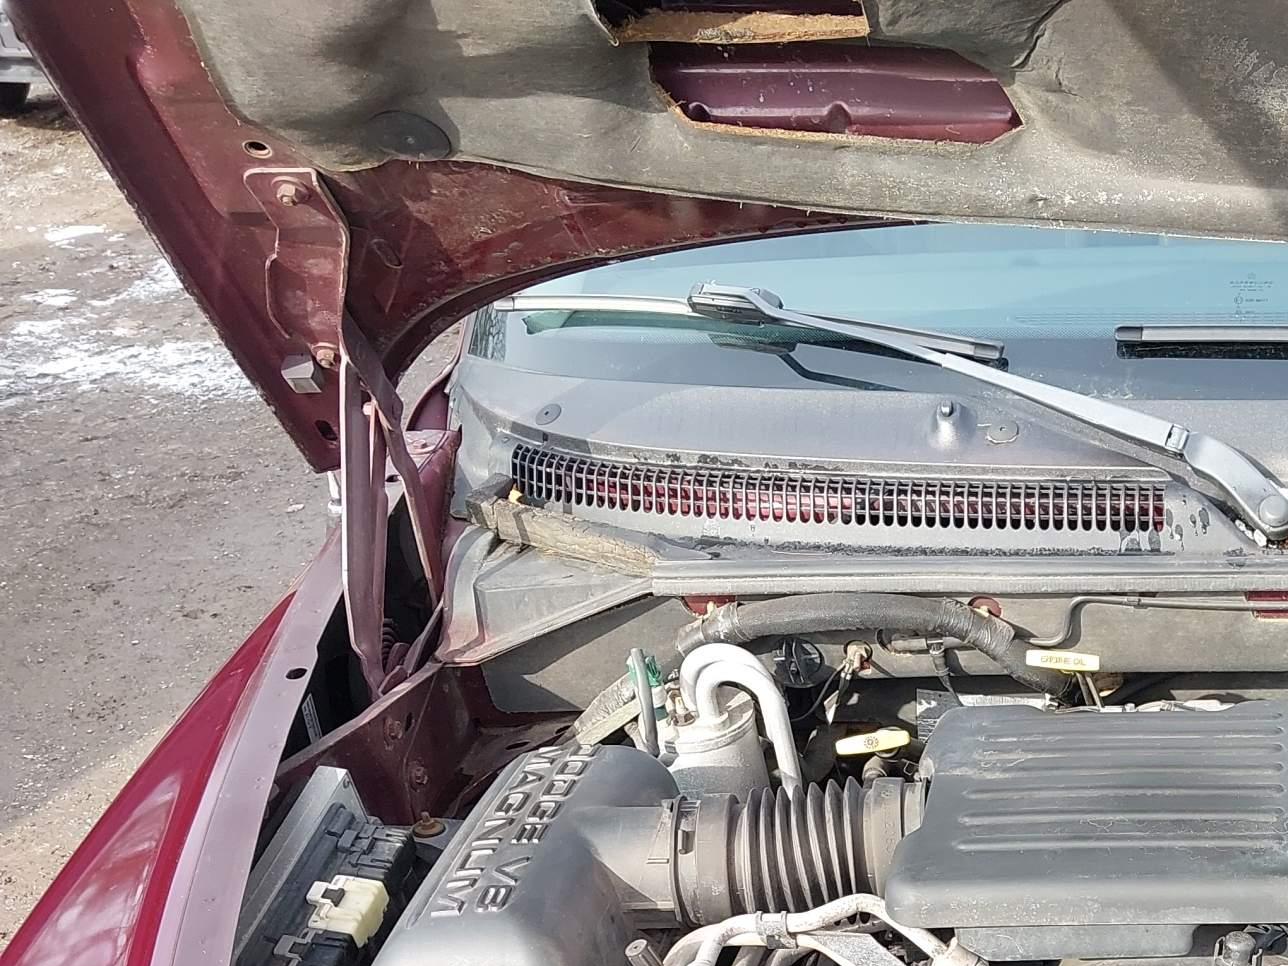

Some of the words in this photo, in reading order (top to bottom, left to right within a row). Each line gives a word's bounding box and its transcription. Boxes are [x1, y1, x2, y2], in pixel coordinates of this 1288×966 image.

[430, 746, 564, 918] MAGNUM
[509, 743, 602, 845] DODGE
[474, 854, 534, 913] V8
